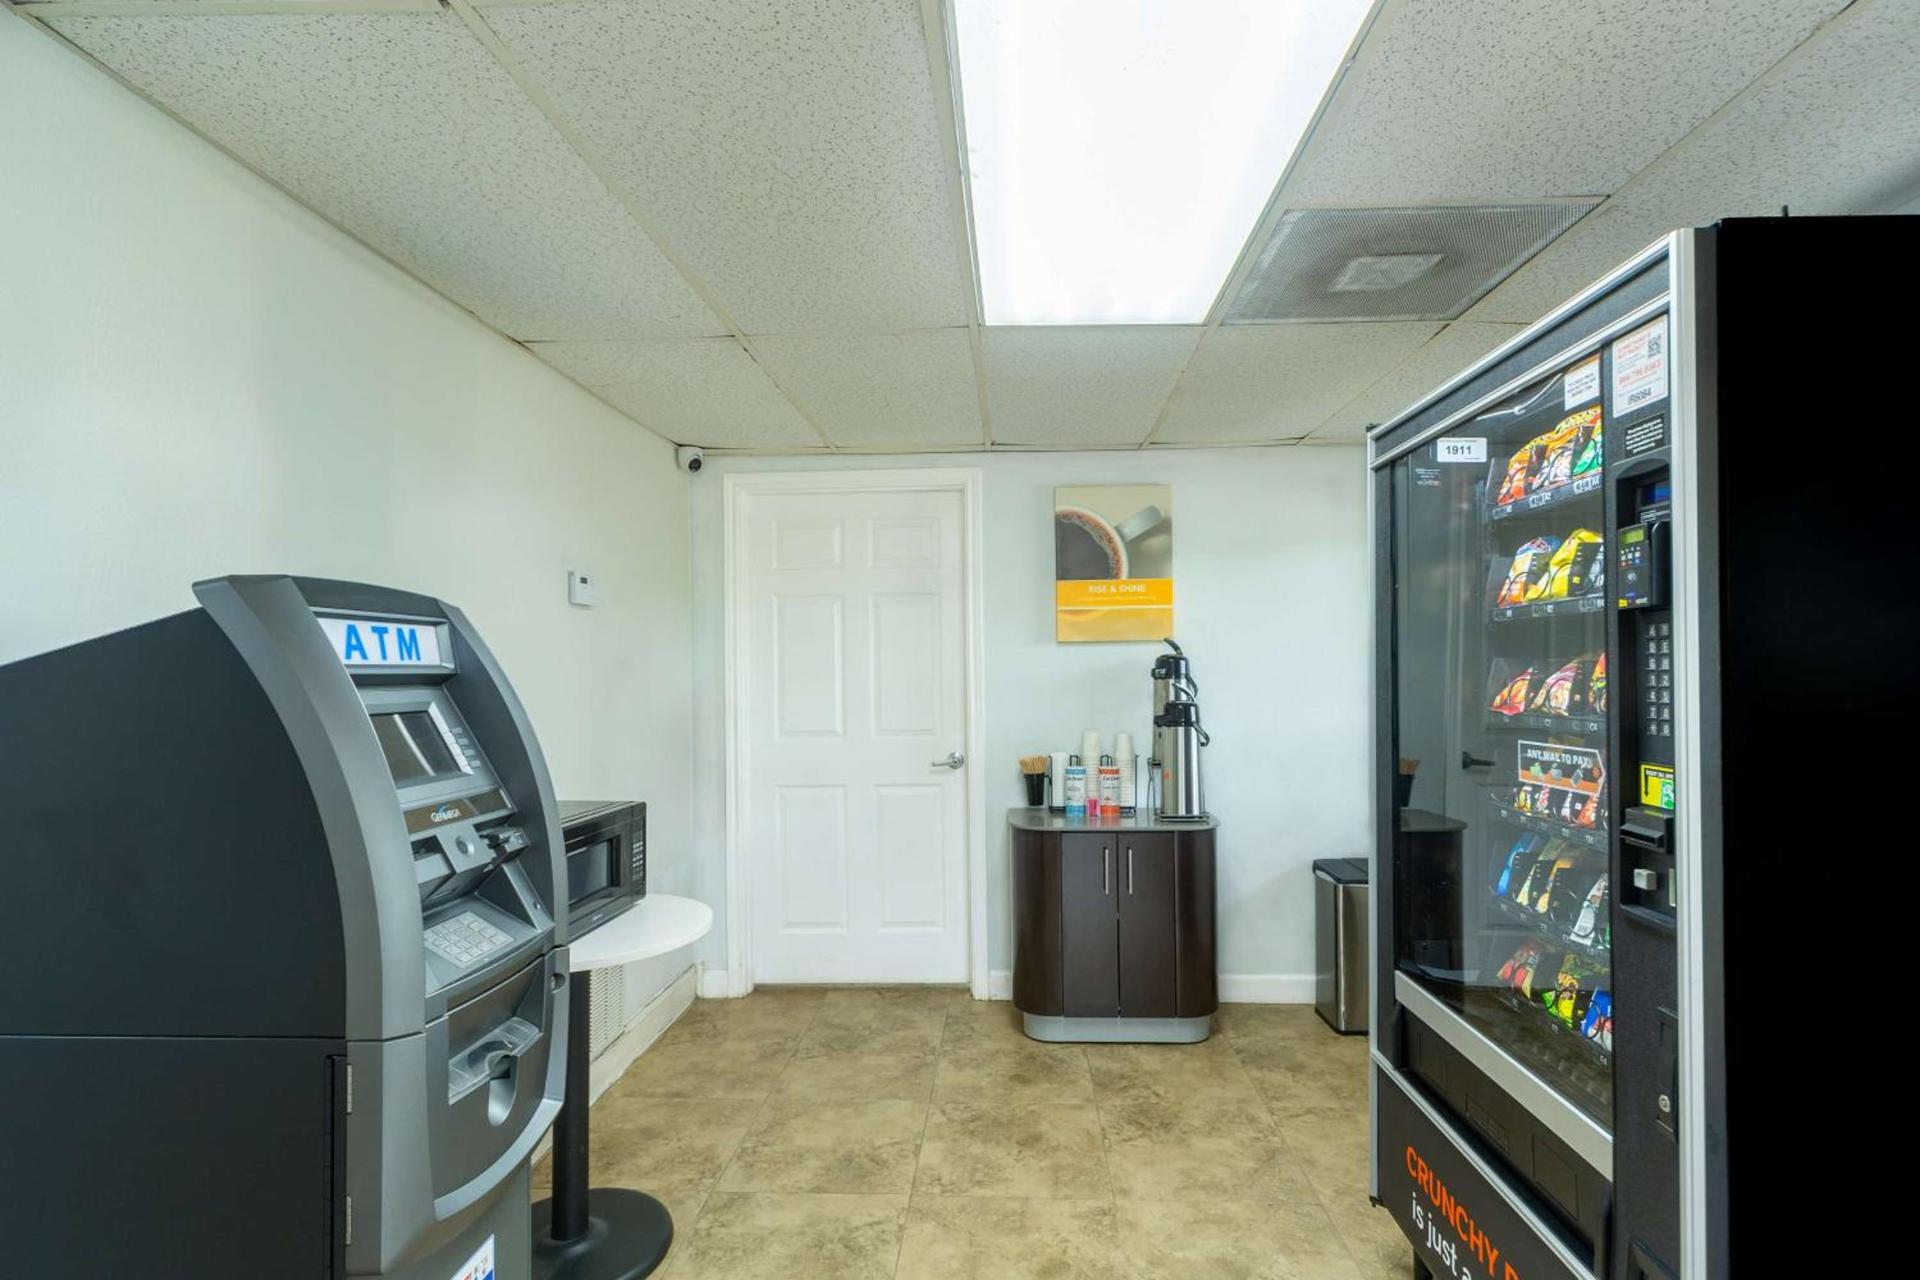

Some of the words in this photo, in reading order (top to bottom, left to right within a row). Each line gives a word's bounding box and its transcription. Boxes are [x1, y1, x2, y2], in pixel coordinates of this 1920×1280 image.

[1445, 444, 1472, 456] 1911
[1119, 583, 1146, 593] SHINE
[345, 624, 422, 661] ATM
[1406, 1145, 1499, 1277] CRUNCHY
[1412, 1191, 1424, 1230] is
[1426, 1212, 1458, 1277] just
